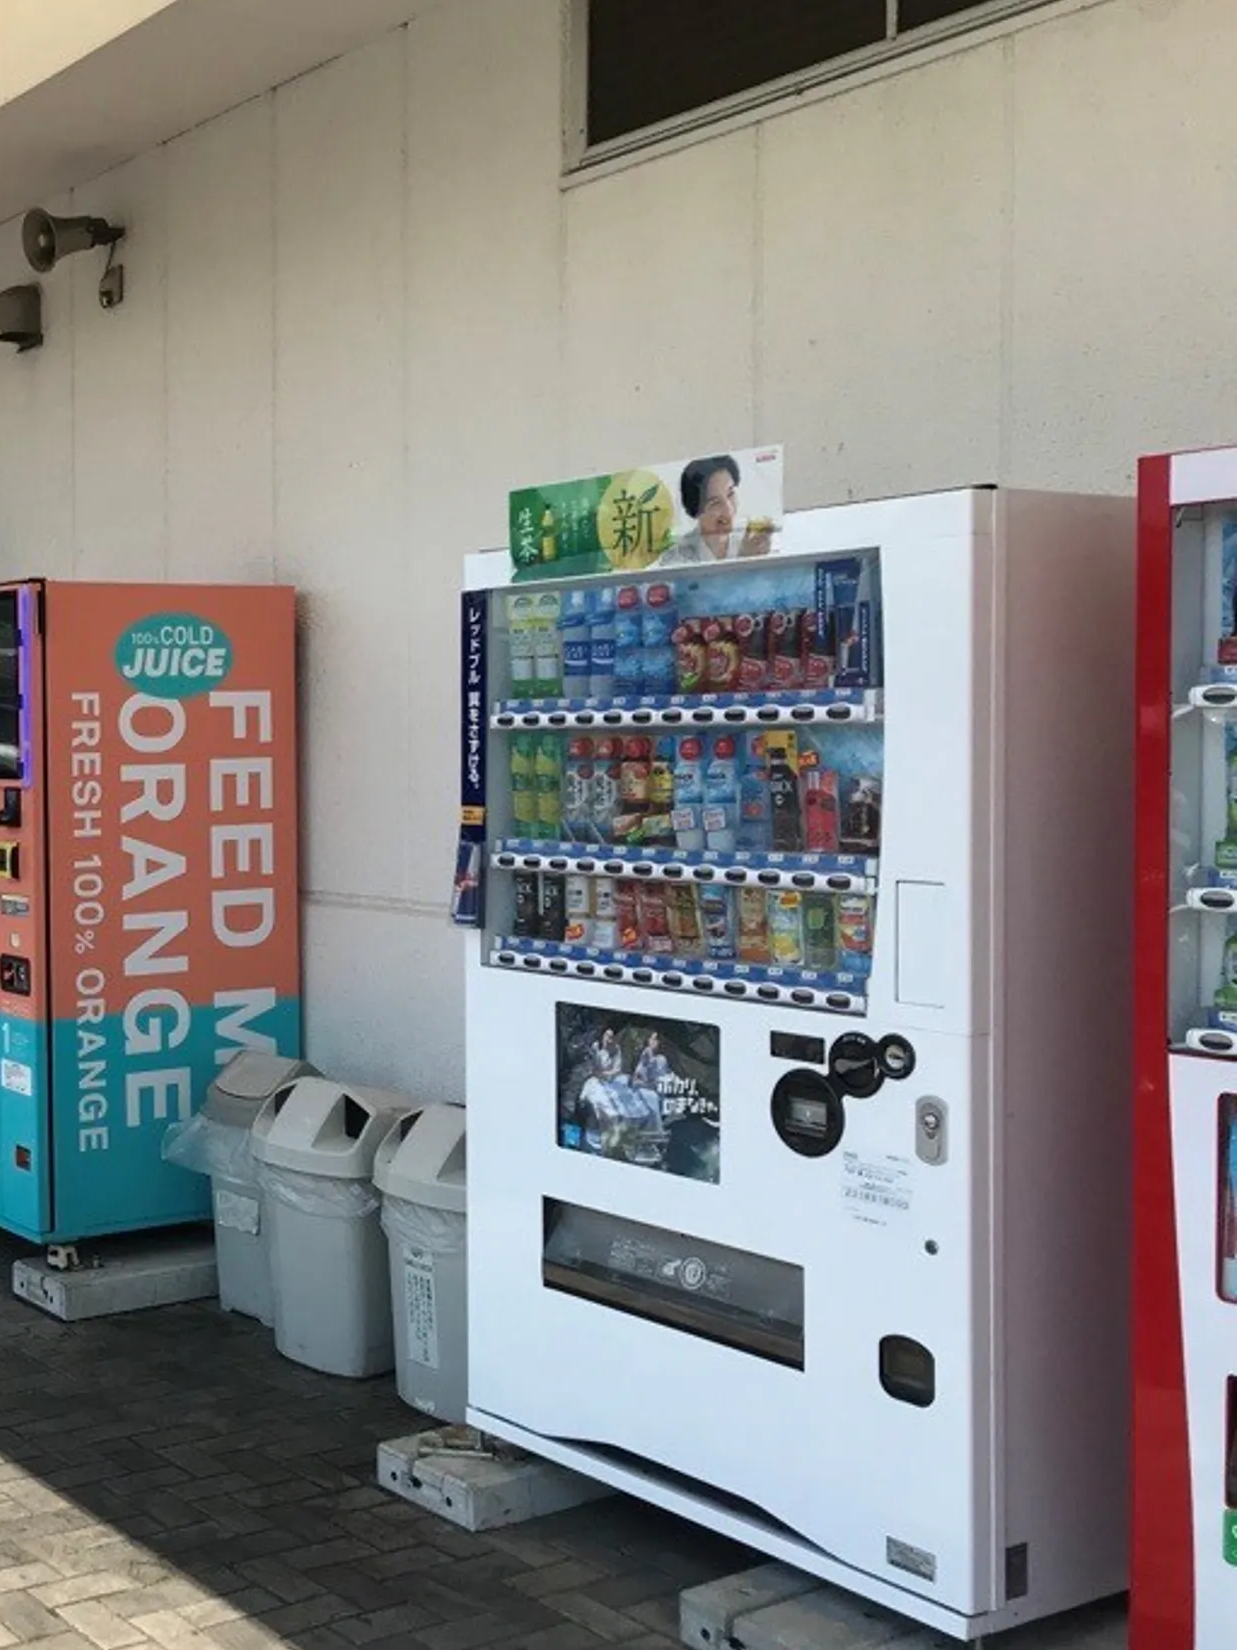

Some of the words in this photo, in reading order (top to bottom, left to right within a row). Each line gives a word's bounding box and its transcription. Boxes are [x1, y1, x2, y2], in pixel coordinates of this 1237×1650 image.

[612, 487, 662, 558] 新
[122, 648, 226, 678] JUICE
[160, 625, 213, 645] COLD
[71, 692, 102, 837] FRESH
[209, 690, 275, 948] FEED
[73, 855, 105, 954] 100%
[118, 691, 193, 1128] ORANGE
[1, 1022, 10, 1052] 1
[76, 968, 109, 1152] ORANGE
[213, 987, 278, 1066] M
